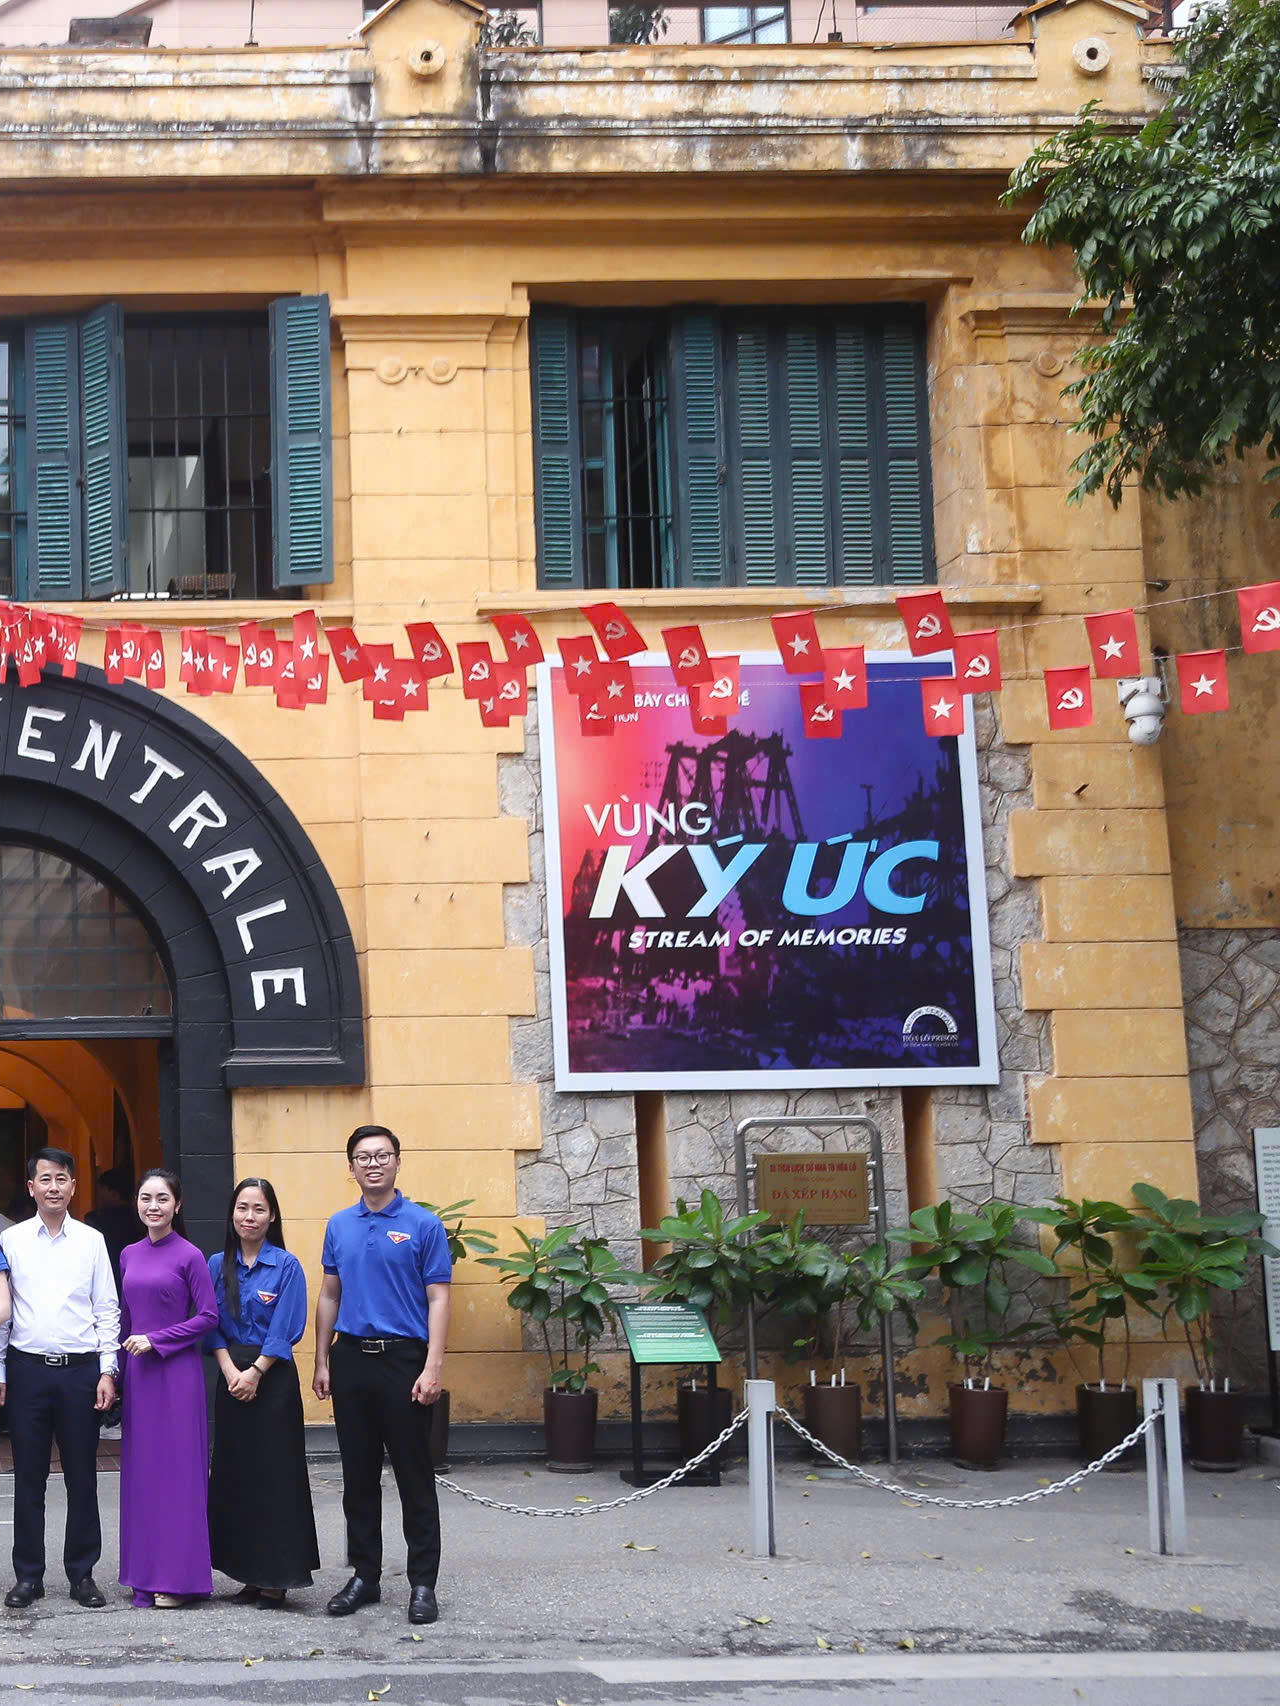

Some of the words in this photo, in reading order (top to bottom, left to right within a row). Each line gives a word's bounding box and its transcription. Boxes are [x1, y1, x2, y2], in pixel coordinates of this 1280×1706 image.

[634, 691, 662, 708] BÀY
[583, 795, 712, 837] VÙNG
[588, 834, 768, 919] KÝ
[782, 832, 940, 916] ỨC
[628, 930, 730, 949] STREAM
[738, 929, 773, 948] OF
[778, 928, 907, 946] MEMORIES
